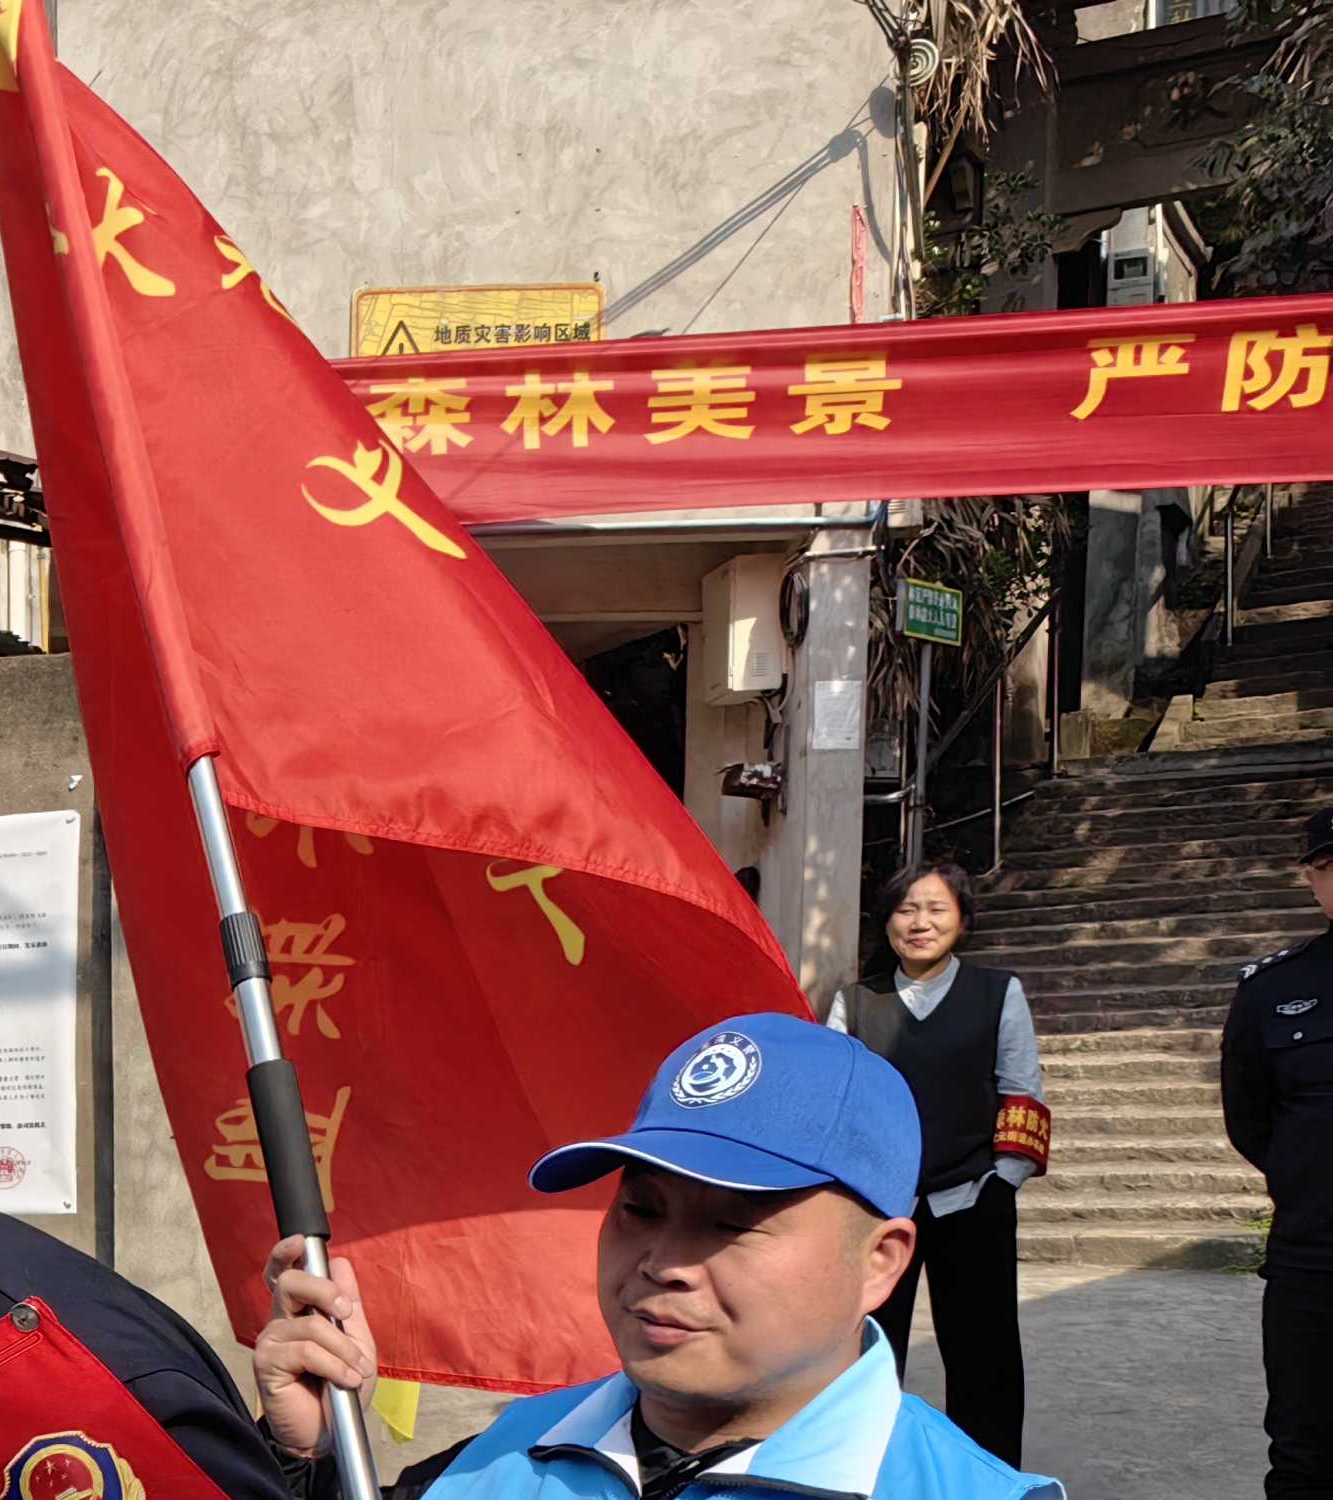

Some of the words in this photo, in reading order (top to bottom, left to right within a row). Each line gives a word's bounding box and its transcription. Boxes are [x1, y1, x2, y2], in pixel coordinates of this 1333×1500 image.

[434, 322, 591, 345] 地质灾害影响区域
[367, 350, 902, 455] 森林美景
[1070, 324, 1333, 419] 严防
